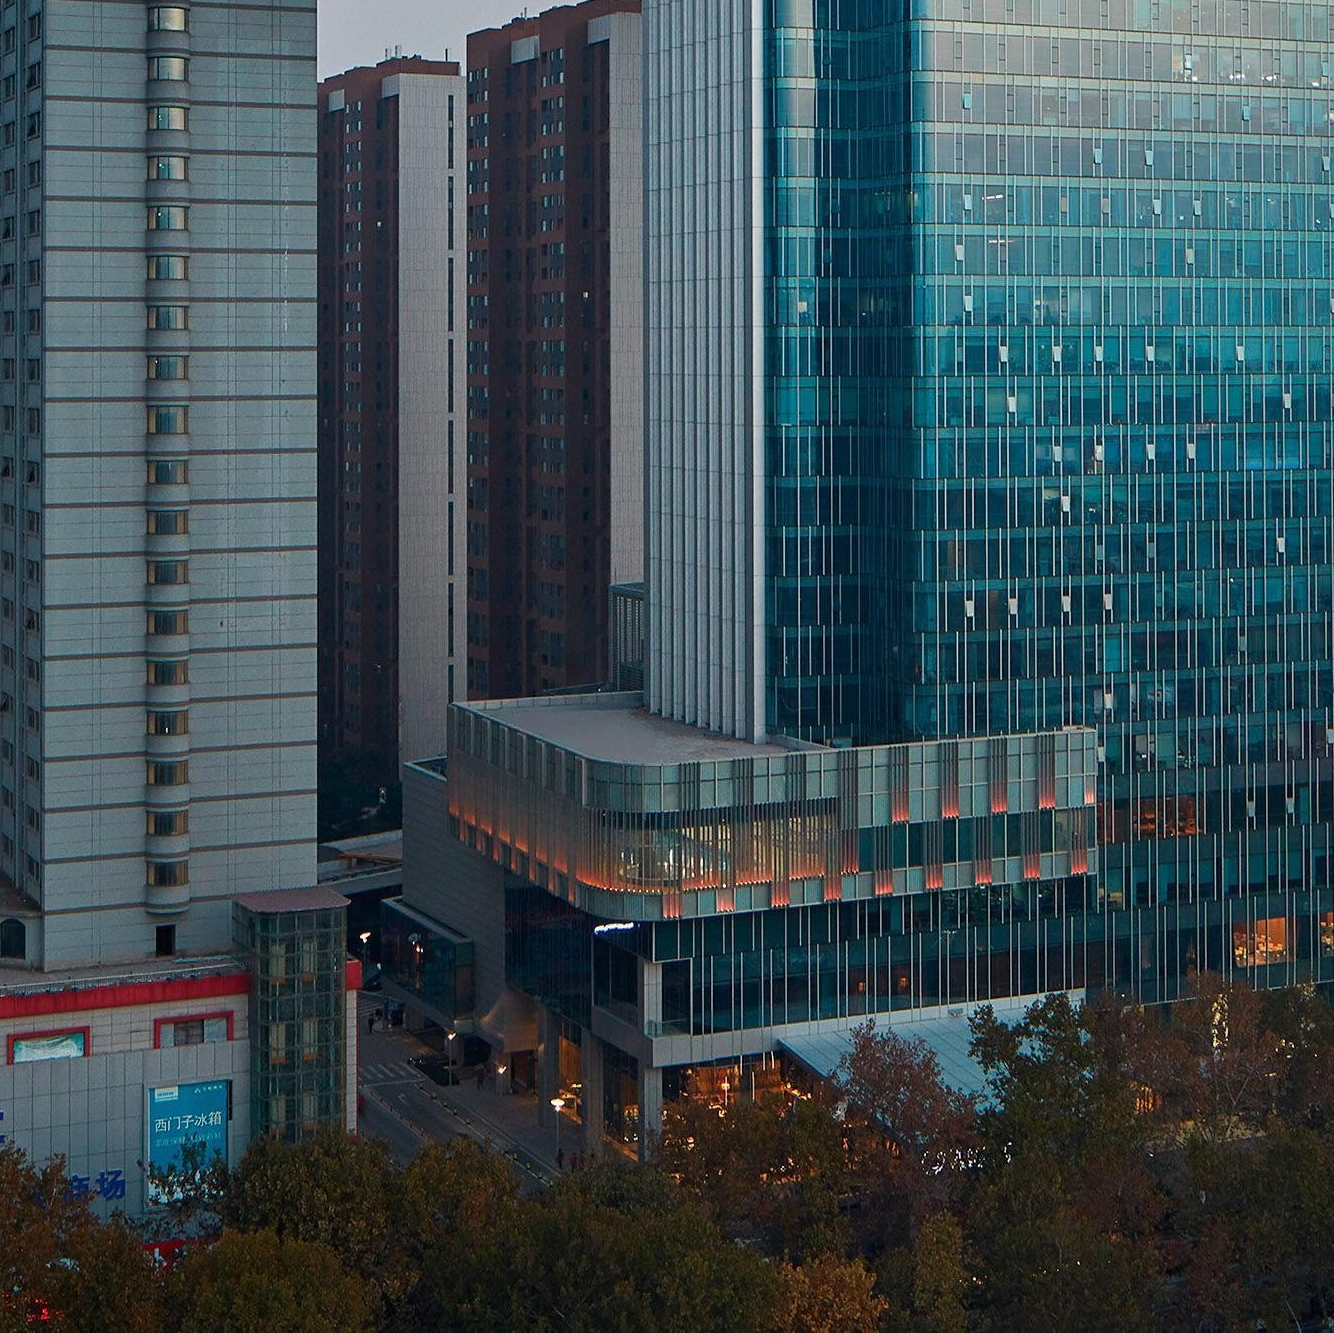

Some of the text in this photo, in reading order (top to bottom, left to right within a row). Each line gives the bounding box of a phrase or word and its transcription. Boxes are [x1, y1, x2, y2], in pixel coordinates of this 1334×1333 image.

[154, 1110, 223, 1133] 西门子冰箱
